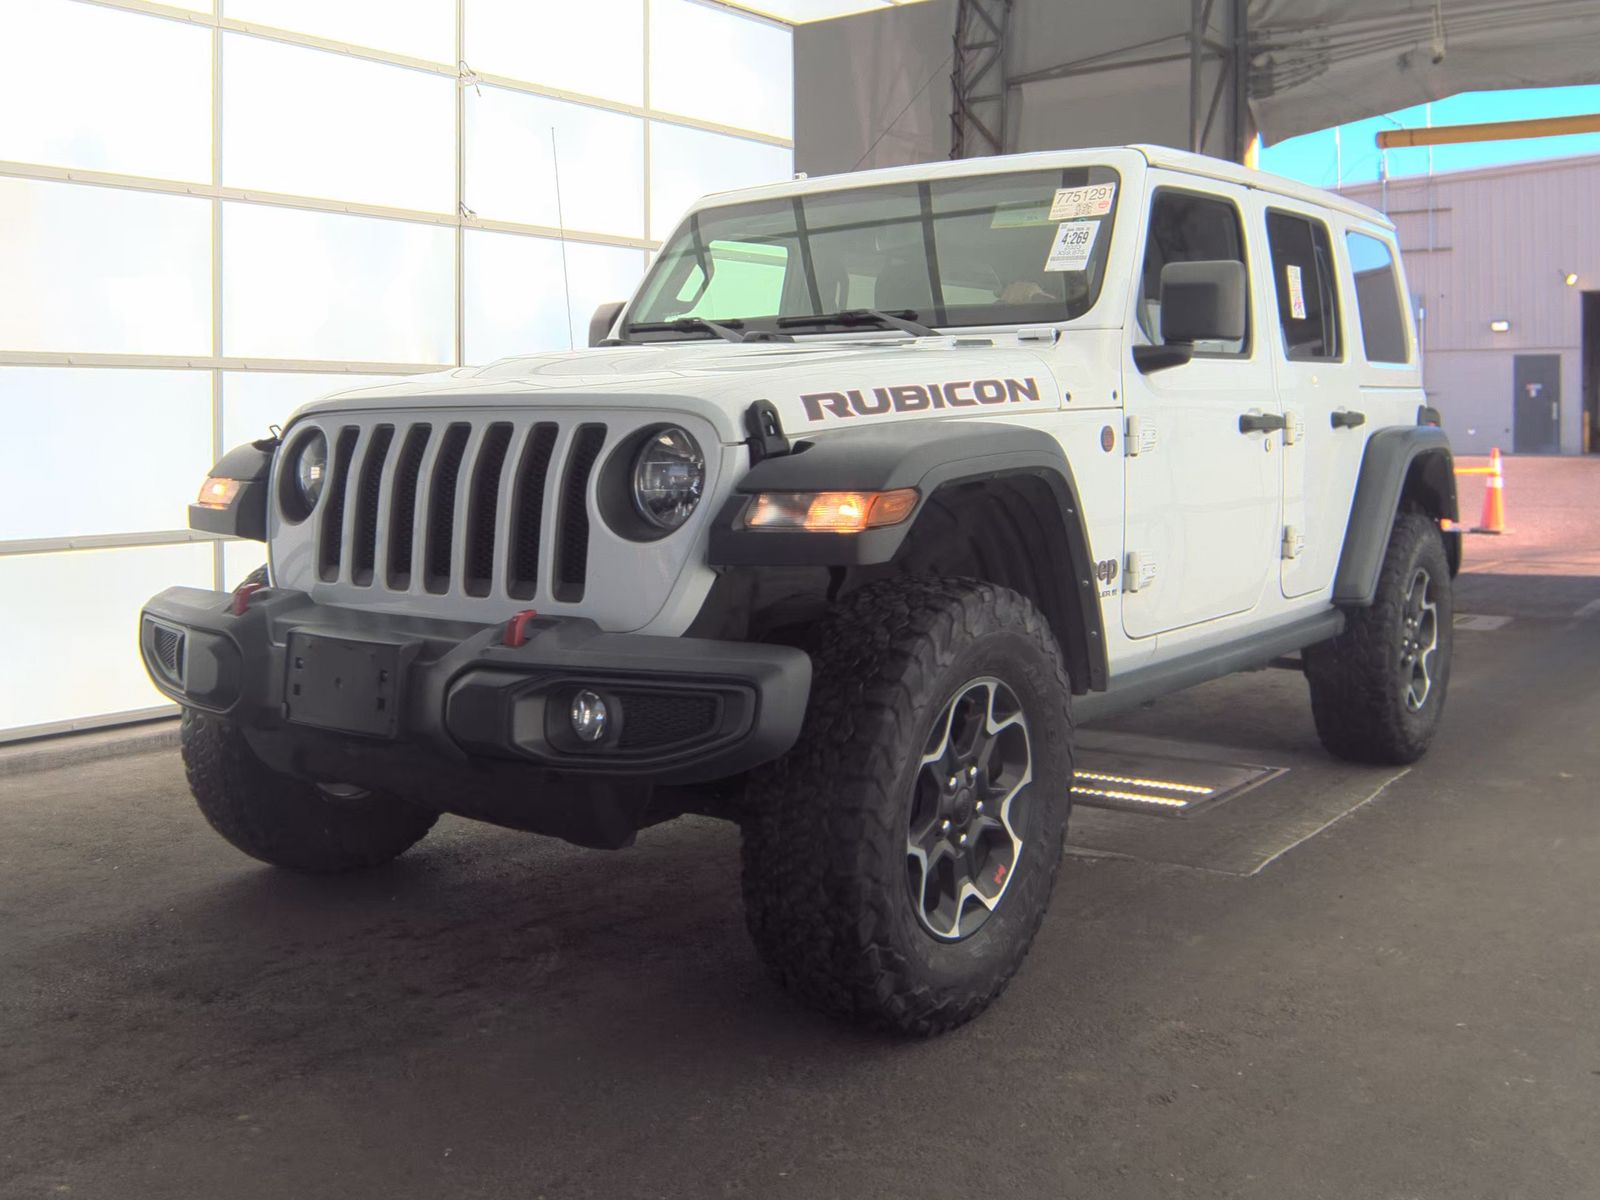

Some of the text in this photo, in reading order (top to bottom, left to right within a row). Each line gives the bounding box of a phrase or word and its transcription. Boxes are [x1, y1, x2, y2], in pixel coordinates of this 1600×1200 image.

[1057, 188, 1113, 204] 7751291
[1061, 231, 1089, 245] 4:269
[799, 377, 1041, 421] RUBICON
